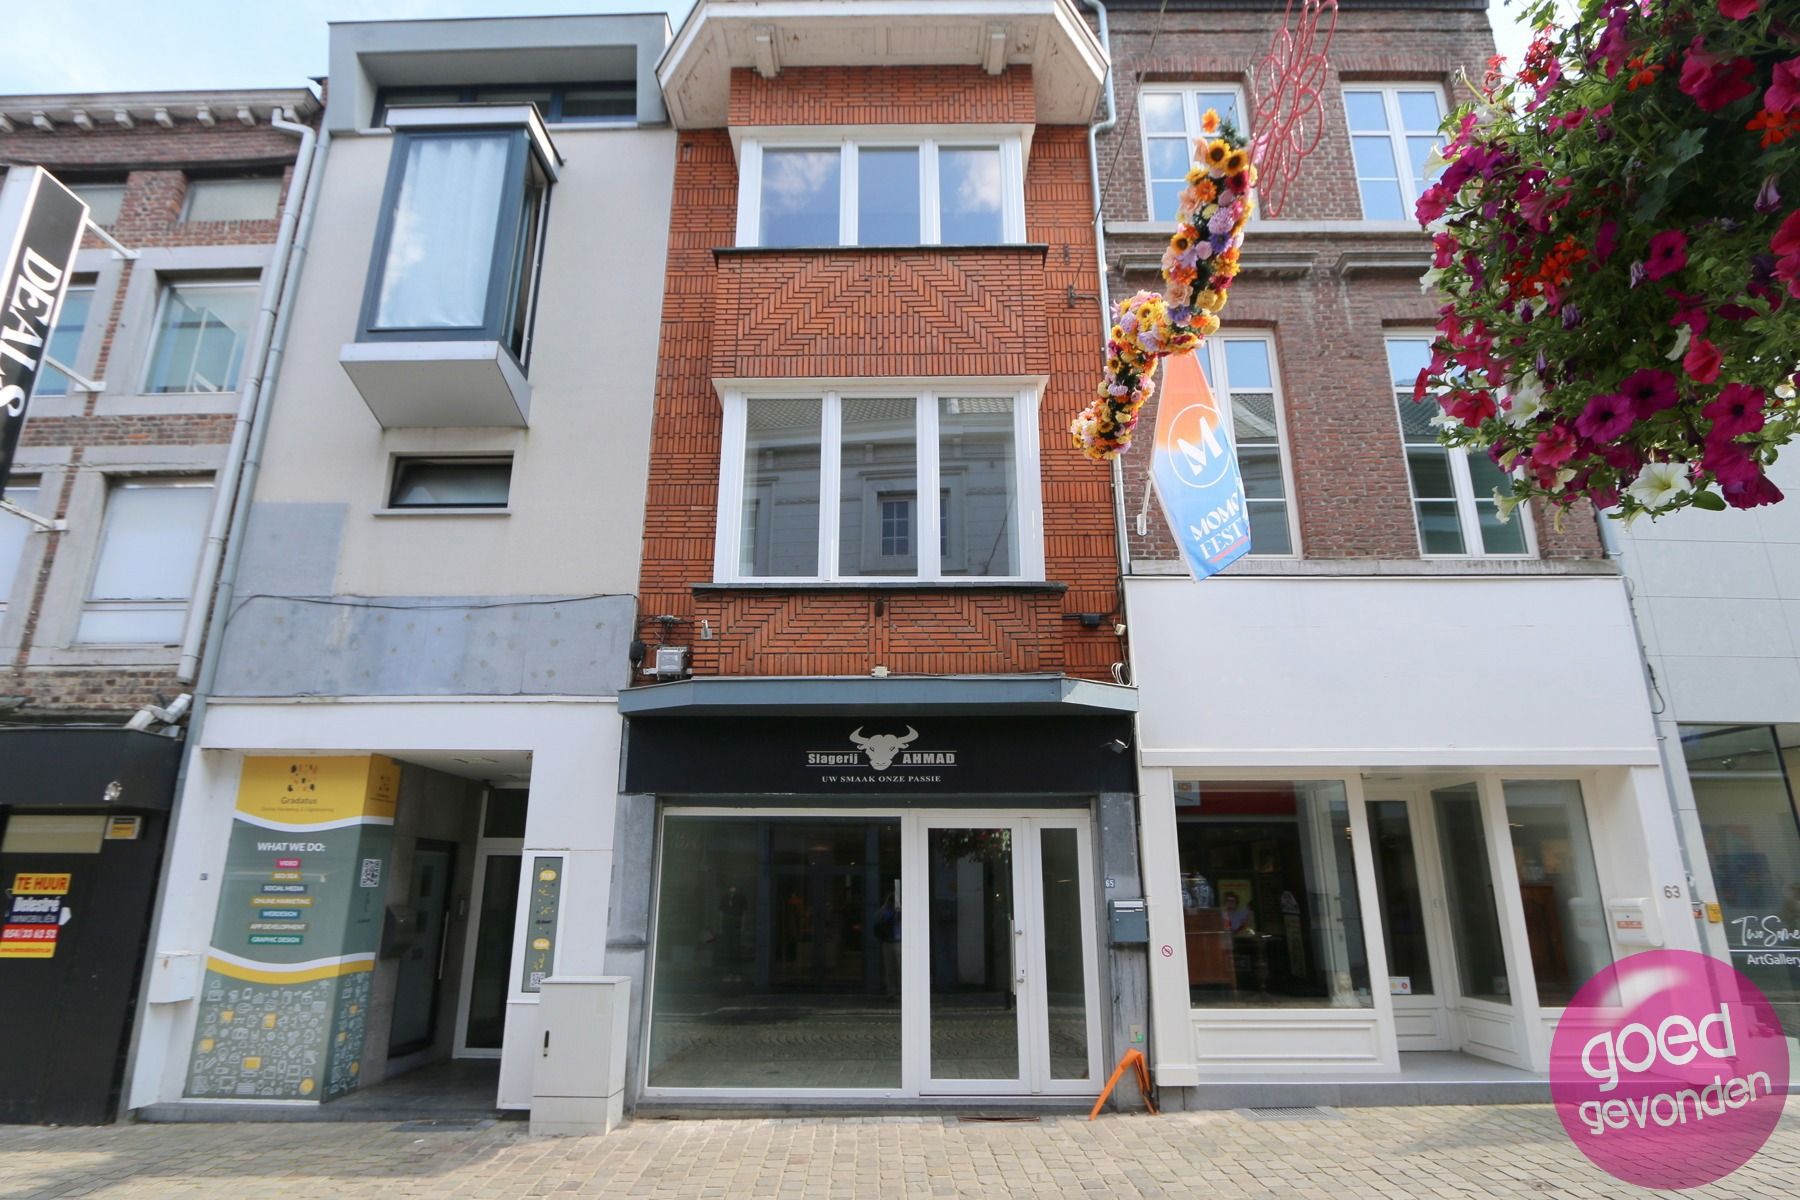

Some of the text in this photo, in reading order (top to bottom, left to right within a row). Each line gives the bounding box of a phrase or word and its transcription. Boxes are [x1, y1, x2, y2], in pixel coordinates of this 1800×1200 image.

[0, 246, 63, 417] DEALS
[1177, 416, 1224, 476] M
[1200, 517, 1243, 560] FEST
[808, 753, 956, 765] Slagerij AHMAD
[821, 775, 942, 783] UW SMAAK ONZE PASSIE
[257, 842, 326, 852] WHAT WE DO:
[16, 876, 69, 890] TE HUUR
[1105, 879, 1115, 888] 65
[1663, 884, 1681, 899] 63
